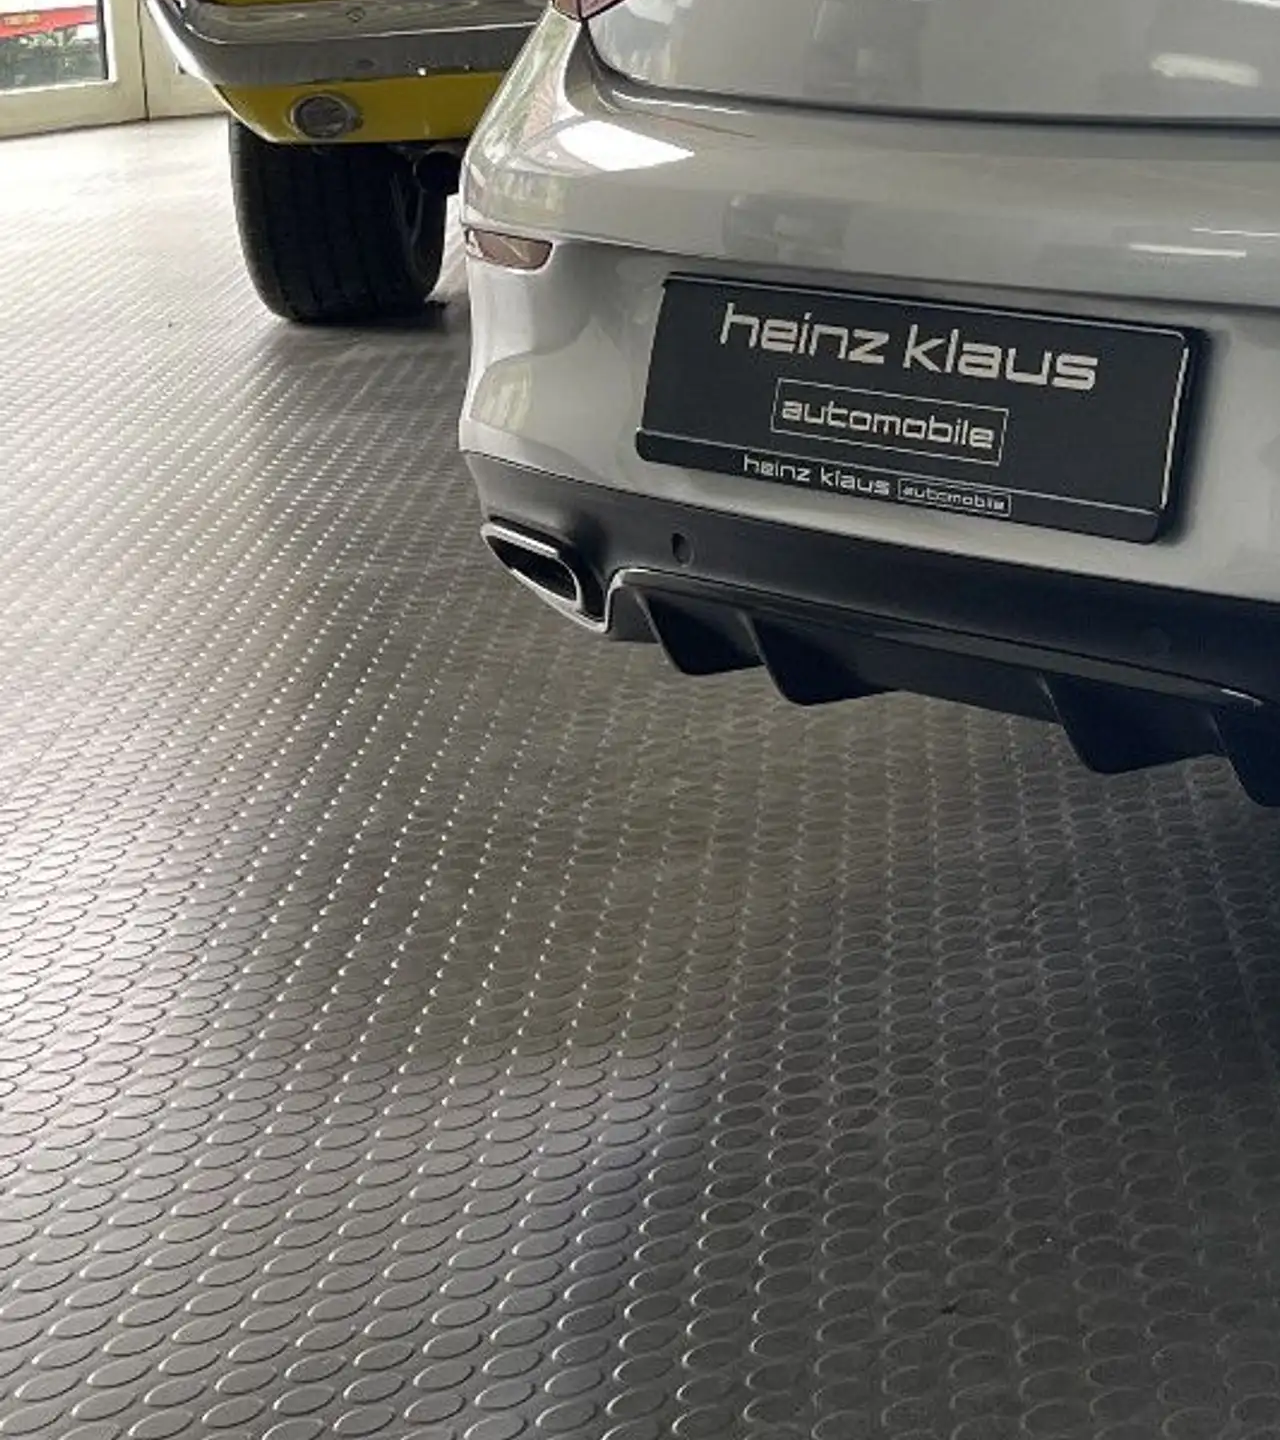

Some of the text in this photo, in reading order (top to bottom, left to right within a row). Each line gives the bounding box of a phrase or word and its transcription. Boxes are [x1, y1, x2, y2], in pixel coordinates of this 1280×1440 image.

[720, 303, 1099, 390] heinz klaus
[781, 401, 995, 448] automobile
[744, 455, 1005, 510] heinz klaus automobile
